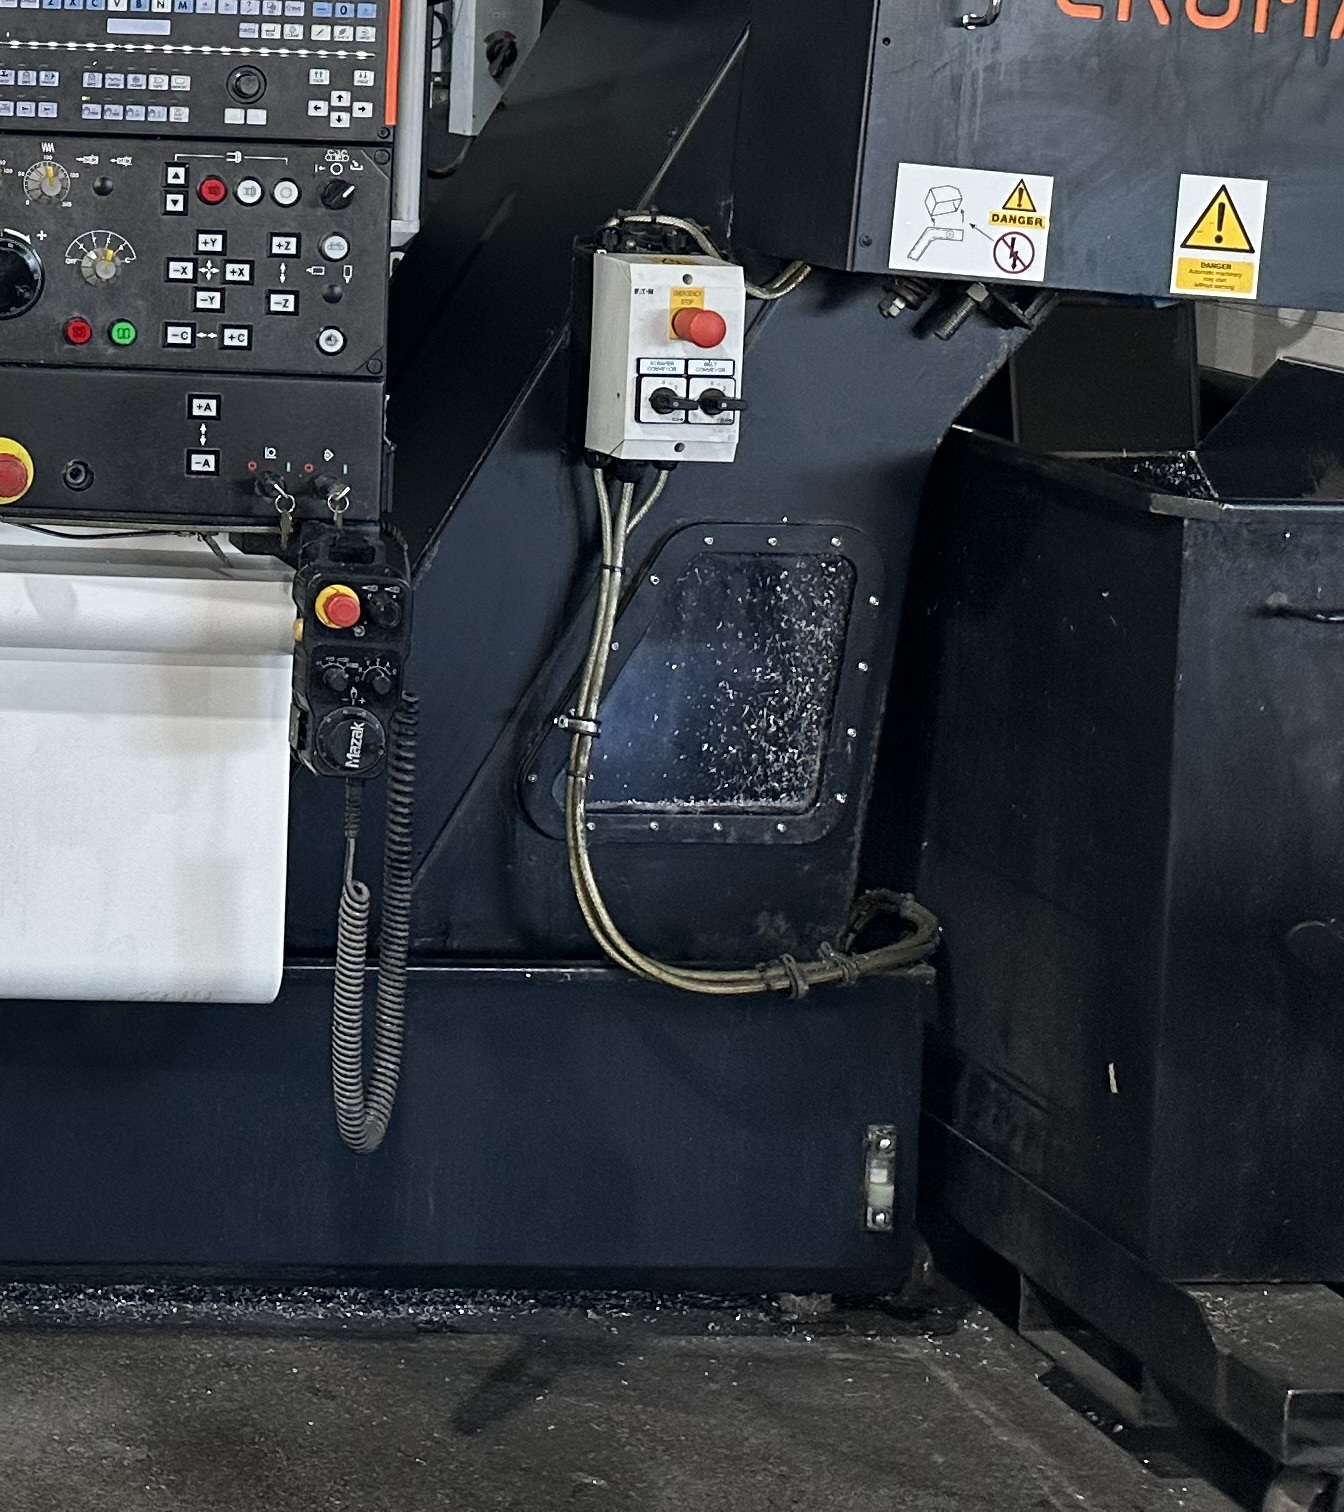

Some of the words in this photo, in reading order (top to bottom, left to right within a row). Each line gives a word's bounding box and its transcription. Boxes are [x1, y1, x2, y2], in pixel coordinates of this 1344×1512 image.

[114, 0, 121, 7] V
[136, 0, 142, 8] B
[178, 1, 187, 10] M
[339, 5, 347, 15] 0
[991, 214, 1043, 227] DANGER
[202, 238, 217, 247] +Y
[276, 241, 292, 251] +Z
[1200, 262, 1231, 270] DANGER
[230, 267, 245, 276] +X
[228, 333, 245, 343] +C
[196, 402, 212, 412] +A
[344, 721, 365, 768] Mazak
